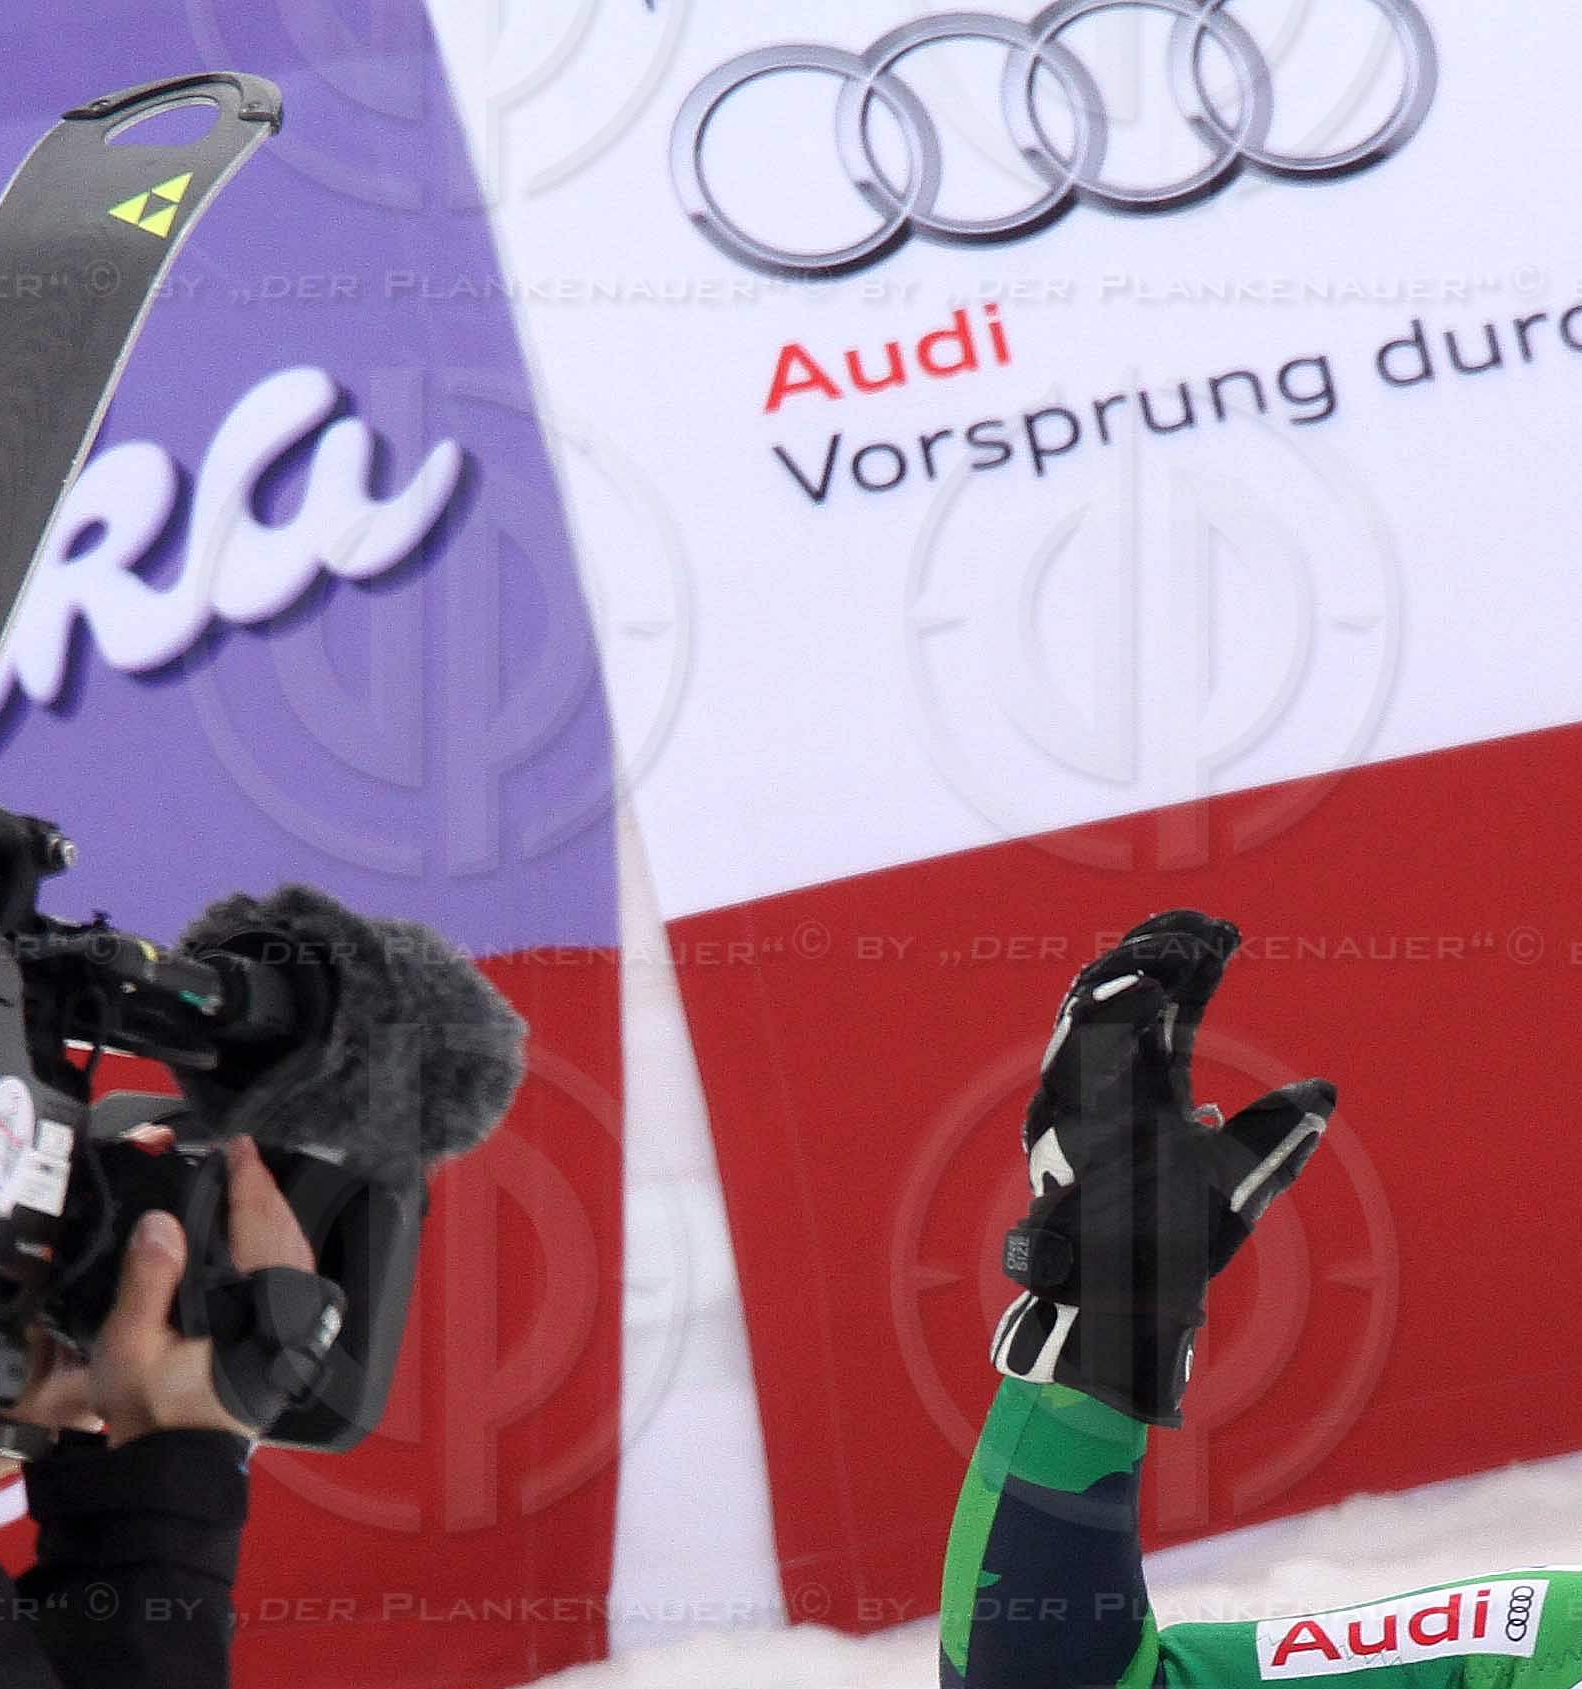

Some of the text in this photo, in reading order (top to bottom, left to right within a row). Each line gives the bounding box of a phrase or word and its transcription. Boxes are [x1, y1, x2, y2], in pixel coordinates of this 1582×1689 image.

[763, 303, 1012, 415] Audi
[772, 353, 1337, 505] Vorsprung
[1271, 1589, 1491, 1666] Audi
